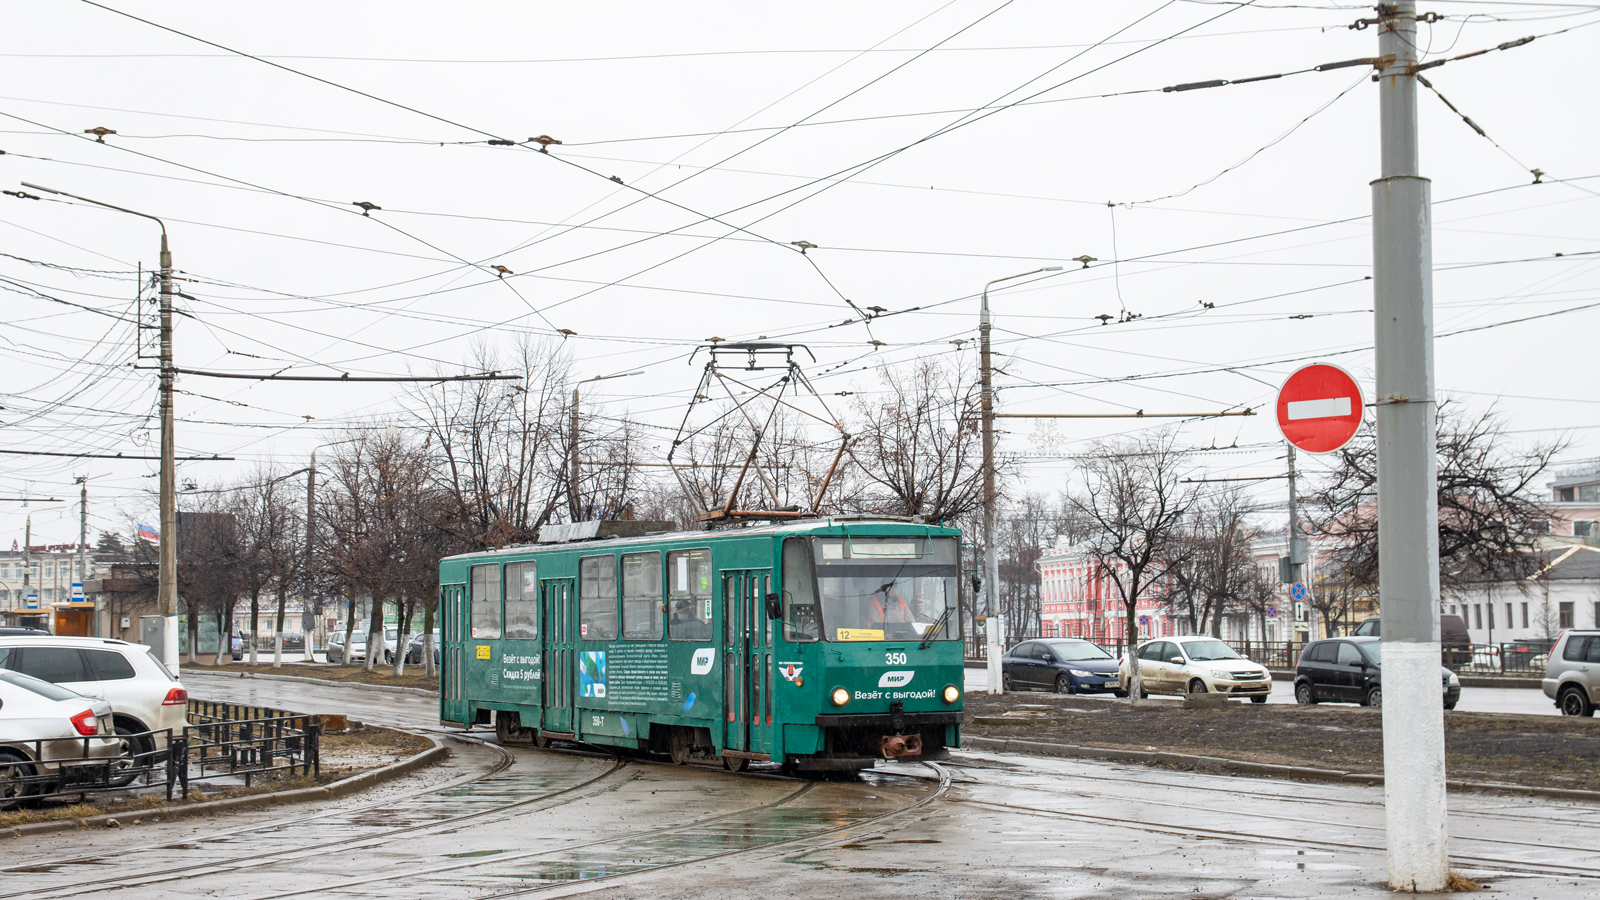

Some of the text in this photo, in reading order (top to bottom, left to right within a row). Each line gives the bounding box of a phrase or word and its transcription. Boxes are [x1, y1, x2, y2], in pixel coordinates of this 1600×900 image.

[839, 630, 850, 640] 12
[503, 653, 516, 664] Везёт
[696, 656, 709, 666] МИР
[885, 652, 907, 665] 350
[503, 668, 540, 681] Скидка 5 рублей
[887, 675, 905, 683] МИР
[854, 690, 883, 700] Везёт
[892, 689, 936, 700] выгодой!
